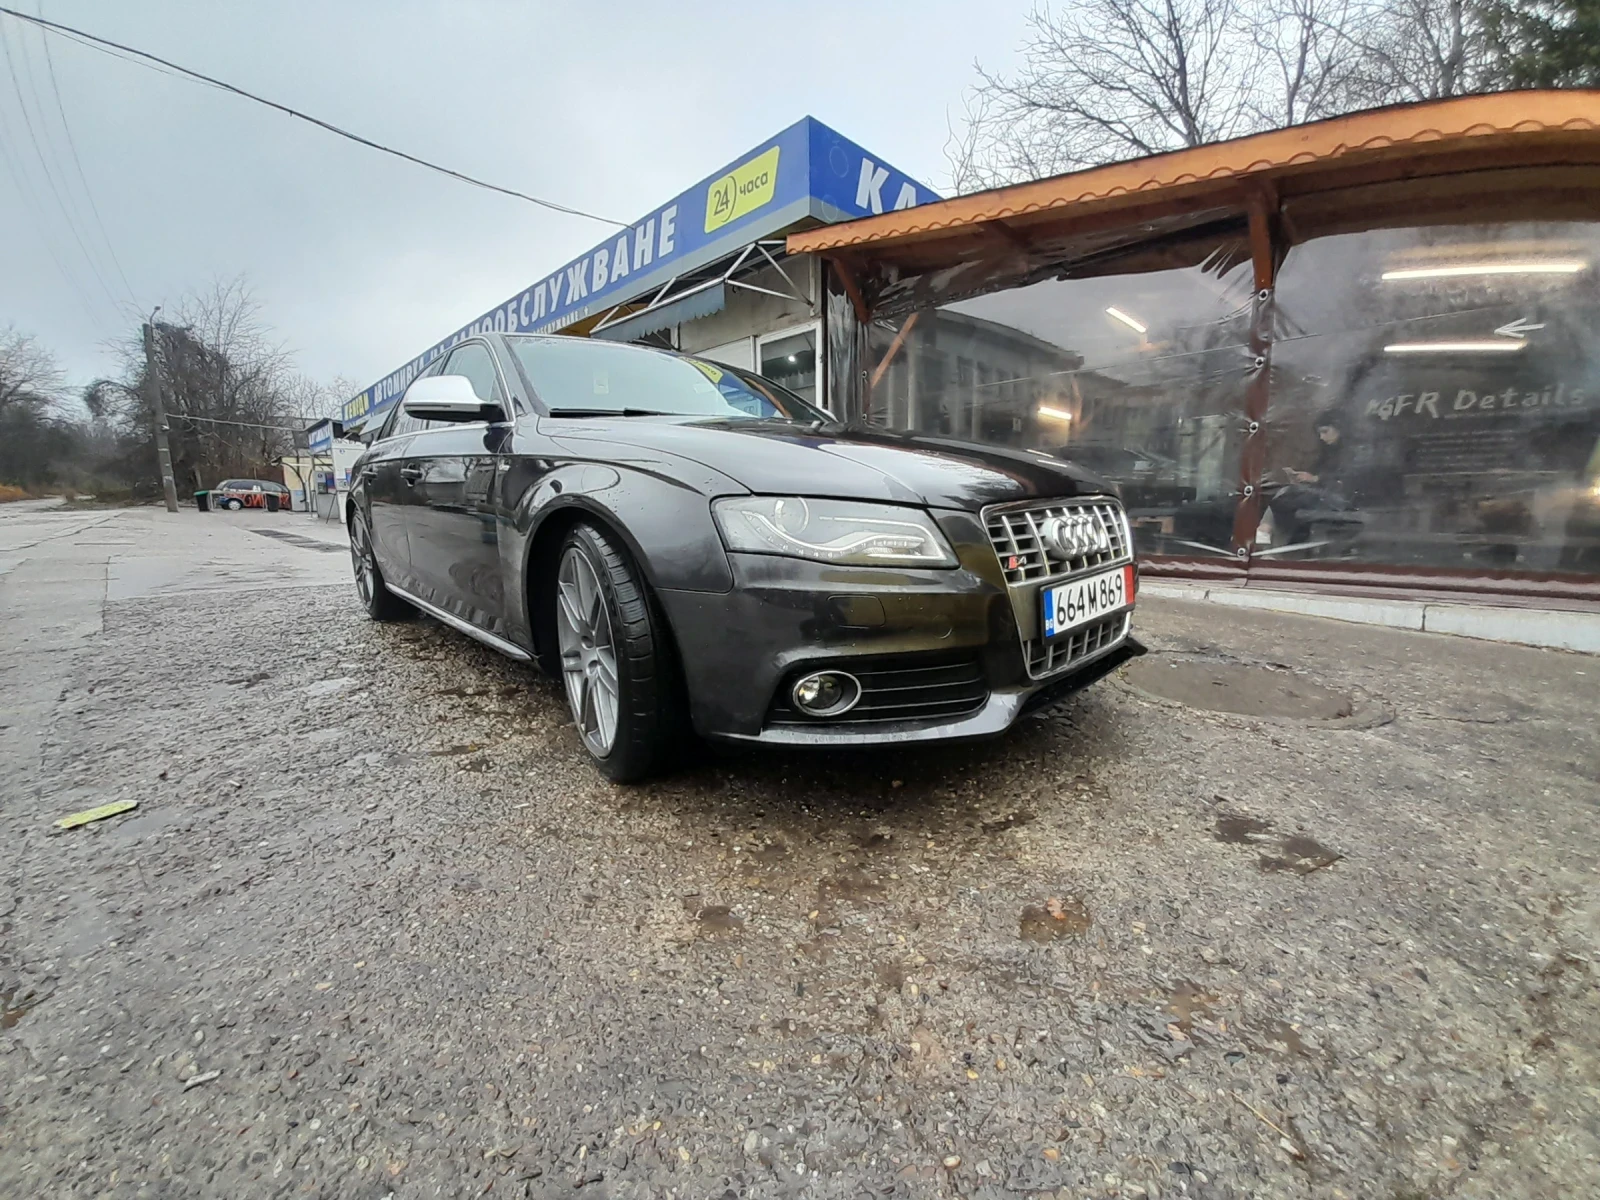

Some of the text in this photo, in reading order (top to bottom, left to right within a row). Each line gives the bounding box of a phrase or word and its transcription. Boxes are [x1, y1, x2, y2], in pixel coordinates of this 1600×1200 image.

[713, 171, 768, 216] 24 часа
[1453, 383, 1585, 411] Details
